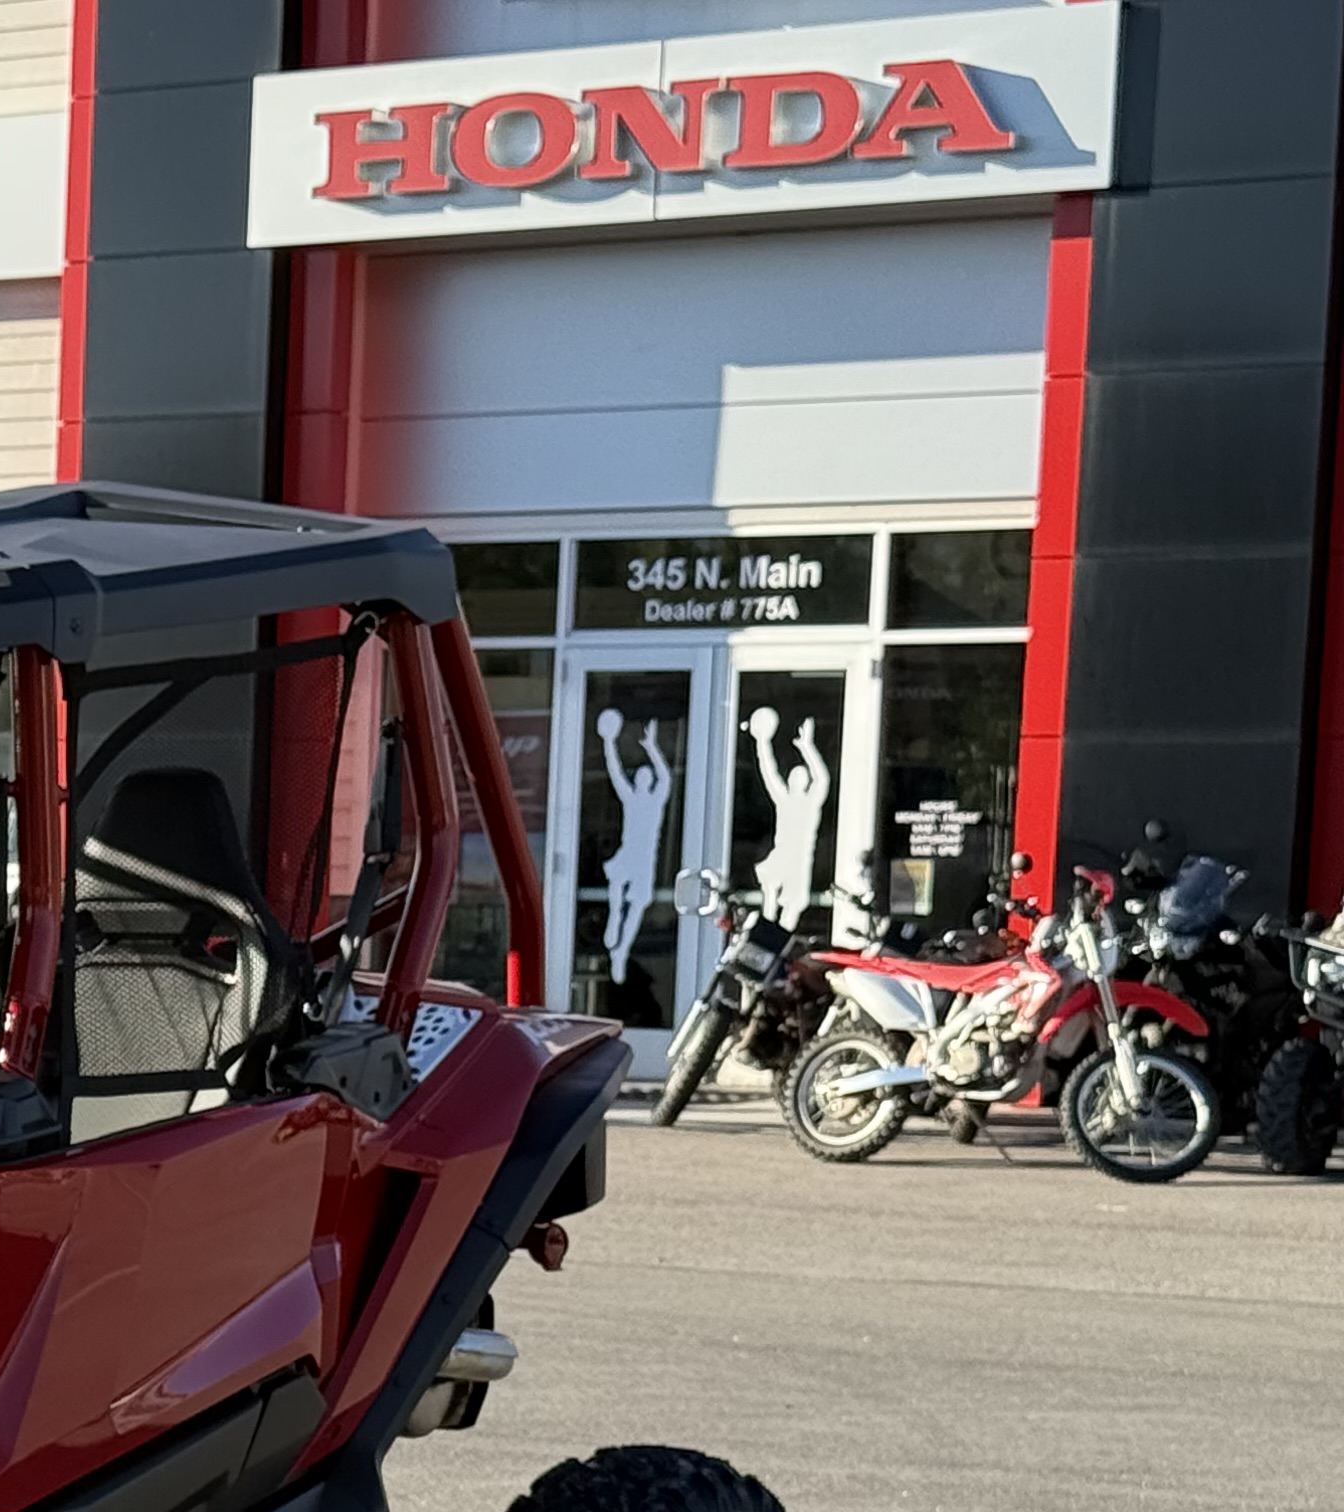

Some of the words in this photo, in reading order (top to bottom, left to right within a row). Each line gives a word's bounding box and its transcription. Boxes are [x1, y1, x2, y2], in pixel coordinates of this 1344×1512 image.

[311, 58, 1015, 199] HONDA
[626, 556, 688, 592] 345
[694, 555, 732, 591] N.
[738, 552, 824, 590] Main
[643, 598, 717, 622] Dealer
[720, 597, 736, 622] #
[740, 594, 801, 622] 775A
